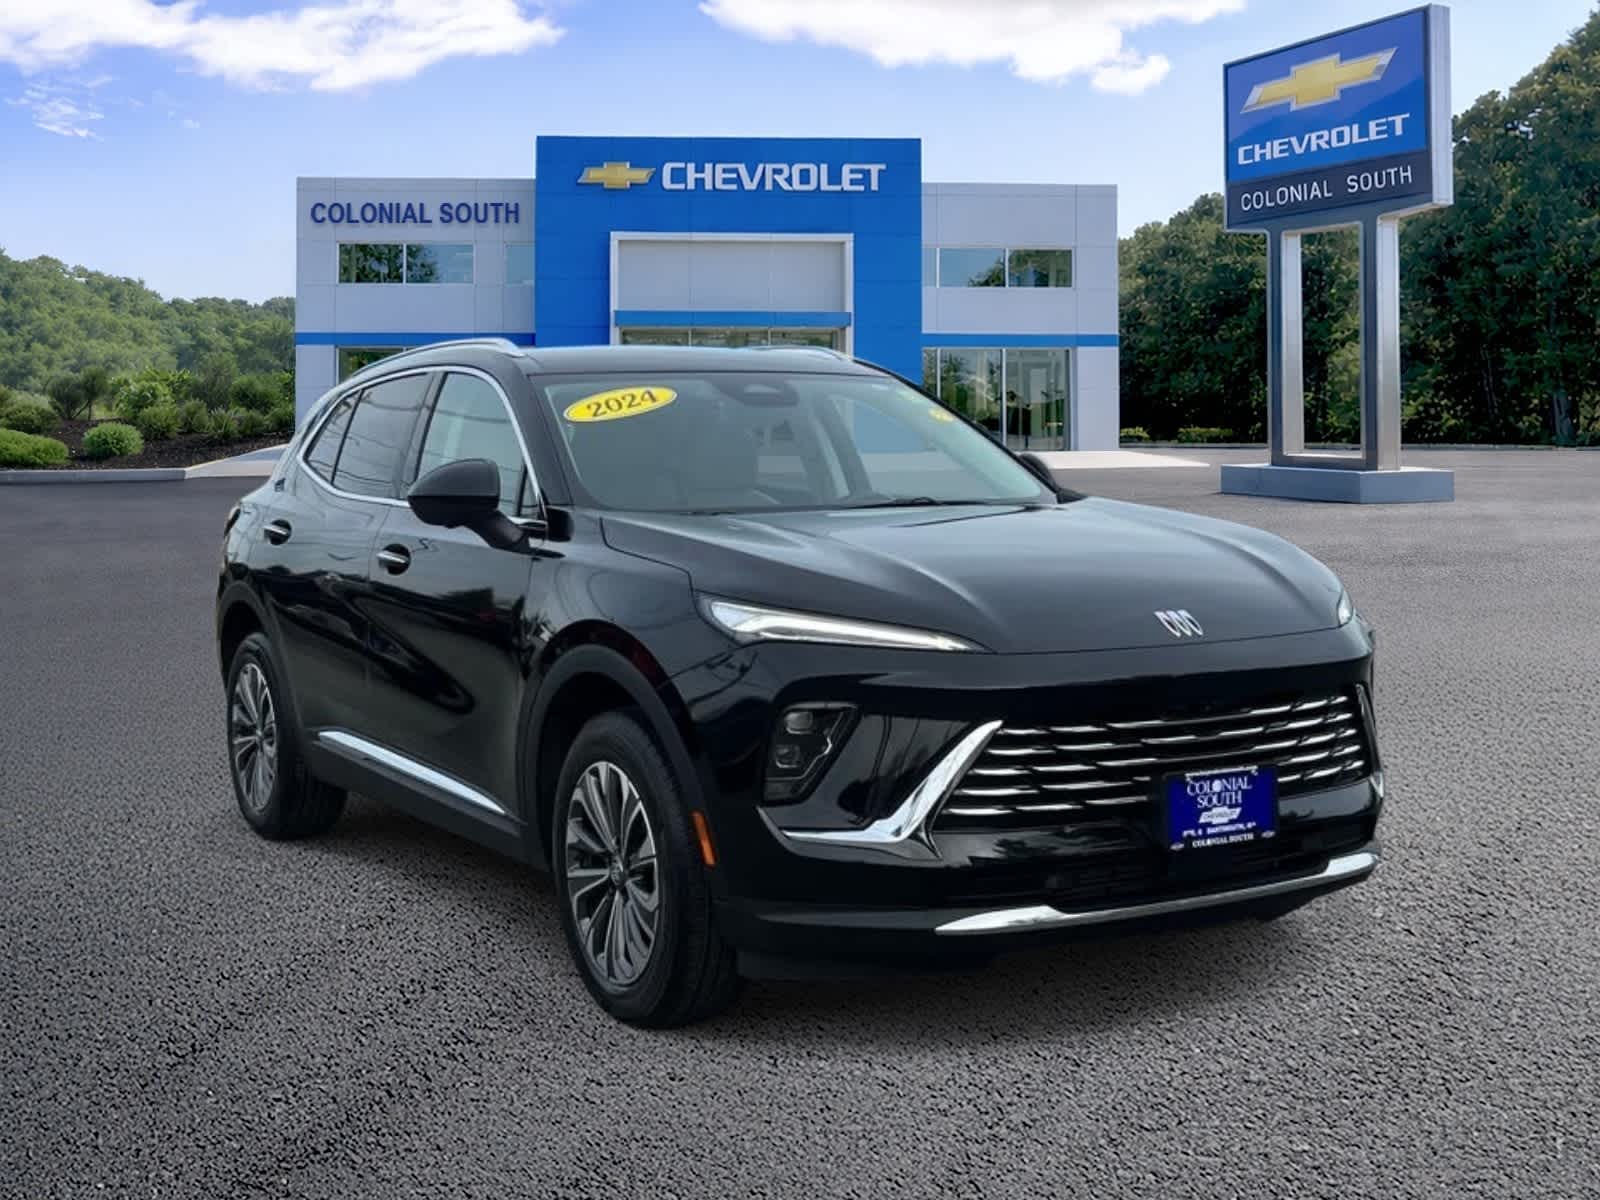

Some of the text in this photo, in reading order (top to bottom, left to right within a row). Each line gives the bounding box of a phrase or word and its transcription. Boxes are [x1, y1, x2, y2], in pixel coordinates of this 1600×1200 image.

[1238, 113, 1410, 165] CHEVROLET
[662, 162, 887, 192] CHEVROLET
[1241, 165, 1412, 211] COLONIAL SOUTH
[310, 202, 520, 225] COLONIAL SOUTH
[586, 389, 657, 417] 2024
[1186, 776, 1252, 796] COLONIAL
[1197, 790, 1242, 808] SOUTH
